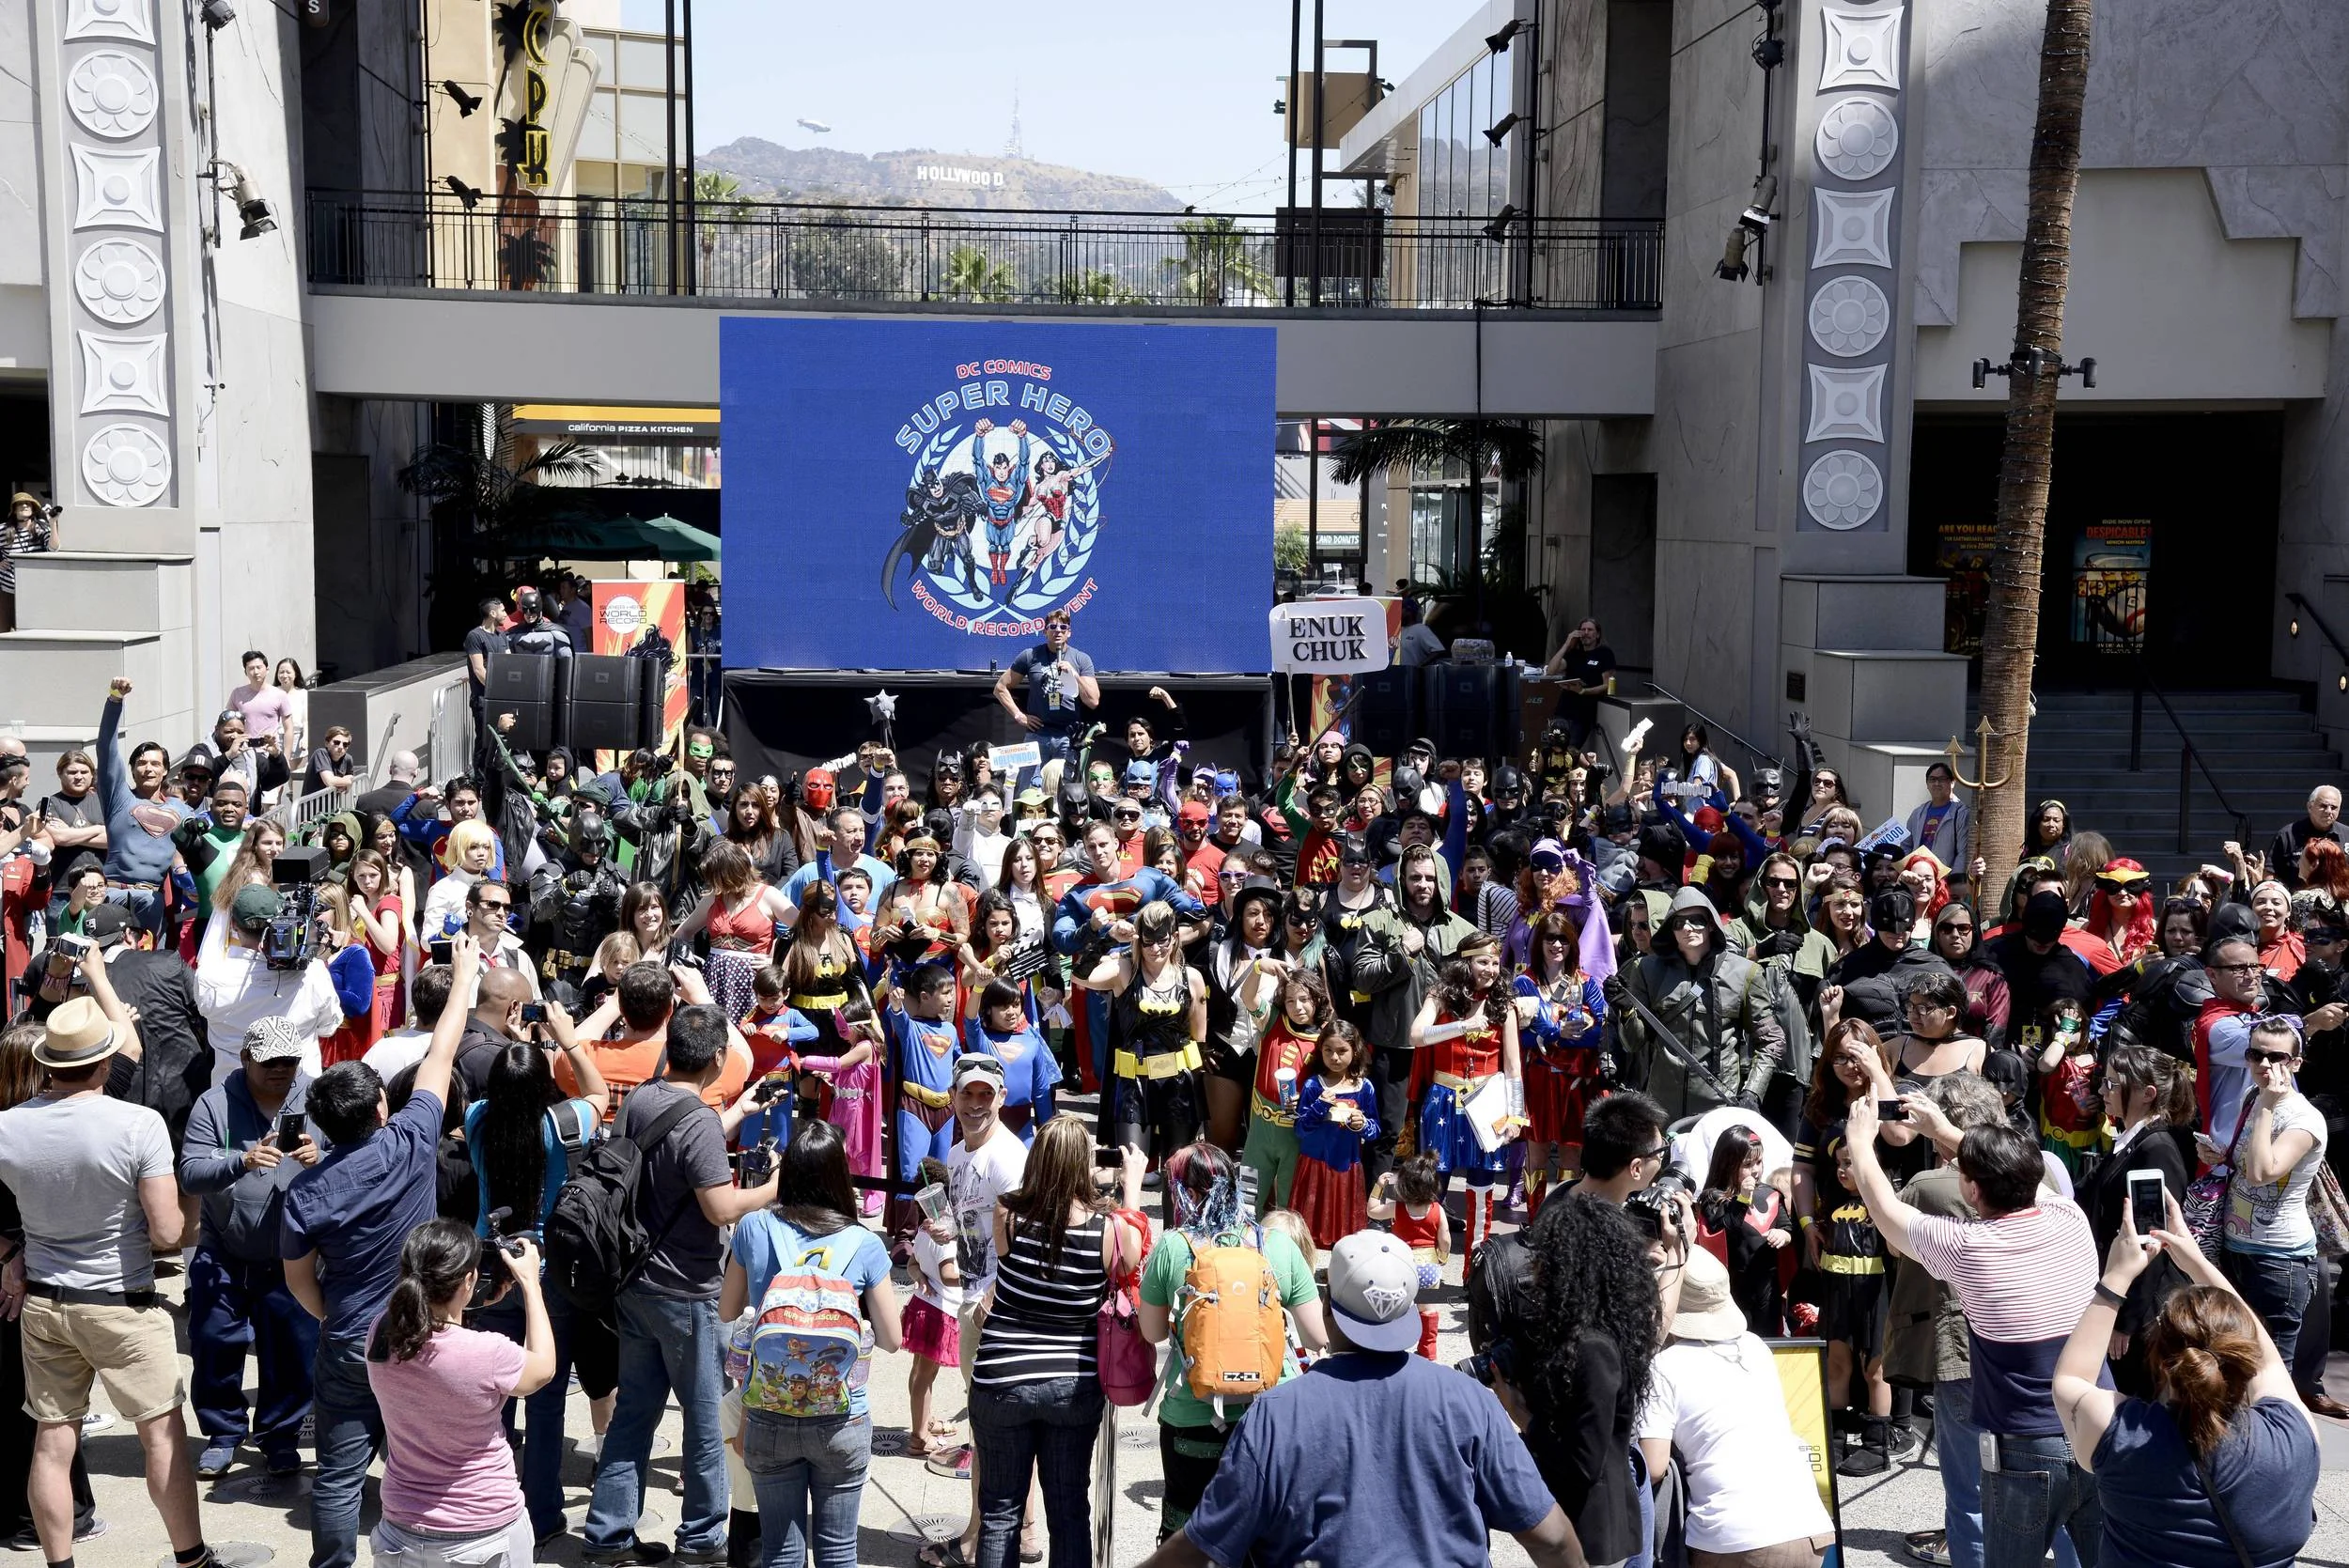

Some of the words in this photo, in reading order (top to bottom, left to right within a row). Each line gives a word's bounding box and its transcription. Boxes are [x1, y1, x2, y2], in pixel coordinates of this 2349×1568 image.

[917, 165, 1004, 186] HOLLYWOOD
[956, 362, 981, 380] DC
[983, 359, 1052, 380] COMICS
[568, 423, 615, 432] california
[894, 380, 1011, 456] SUPER
[1020, 381, 1113, 458] HERO
[1332, 535, 1360, 544] DONUTS
[910, 579, 969, 629] WORLD
[972, 616, 1046, 637] RECORD
[1058, 577, 1098, 617] VENT
[1288, 615, 1365, 638] ENUK
[1292, 638, 1369, 661] CHUK
